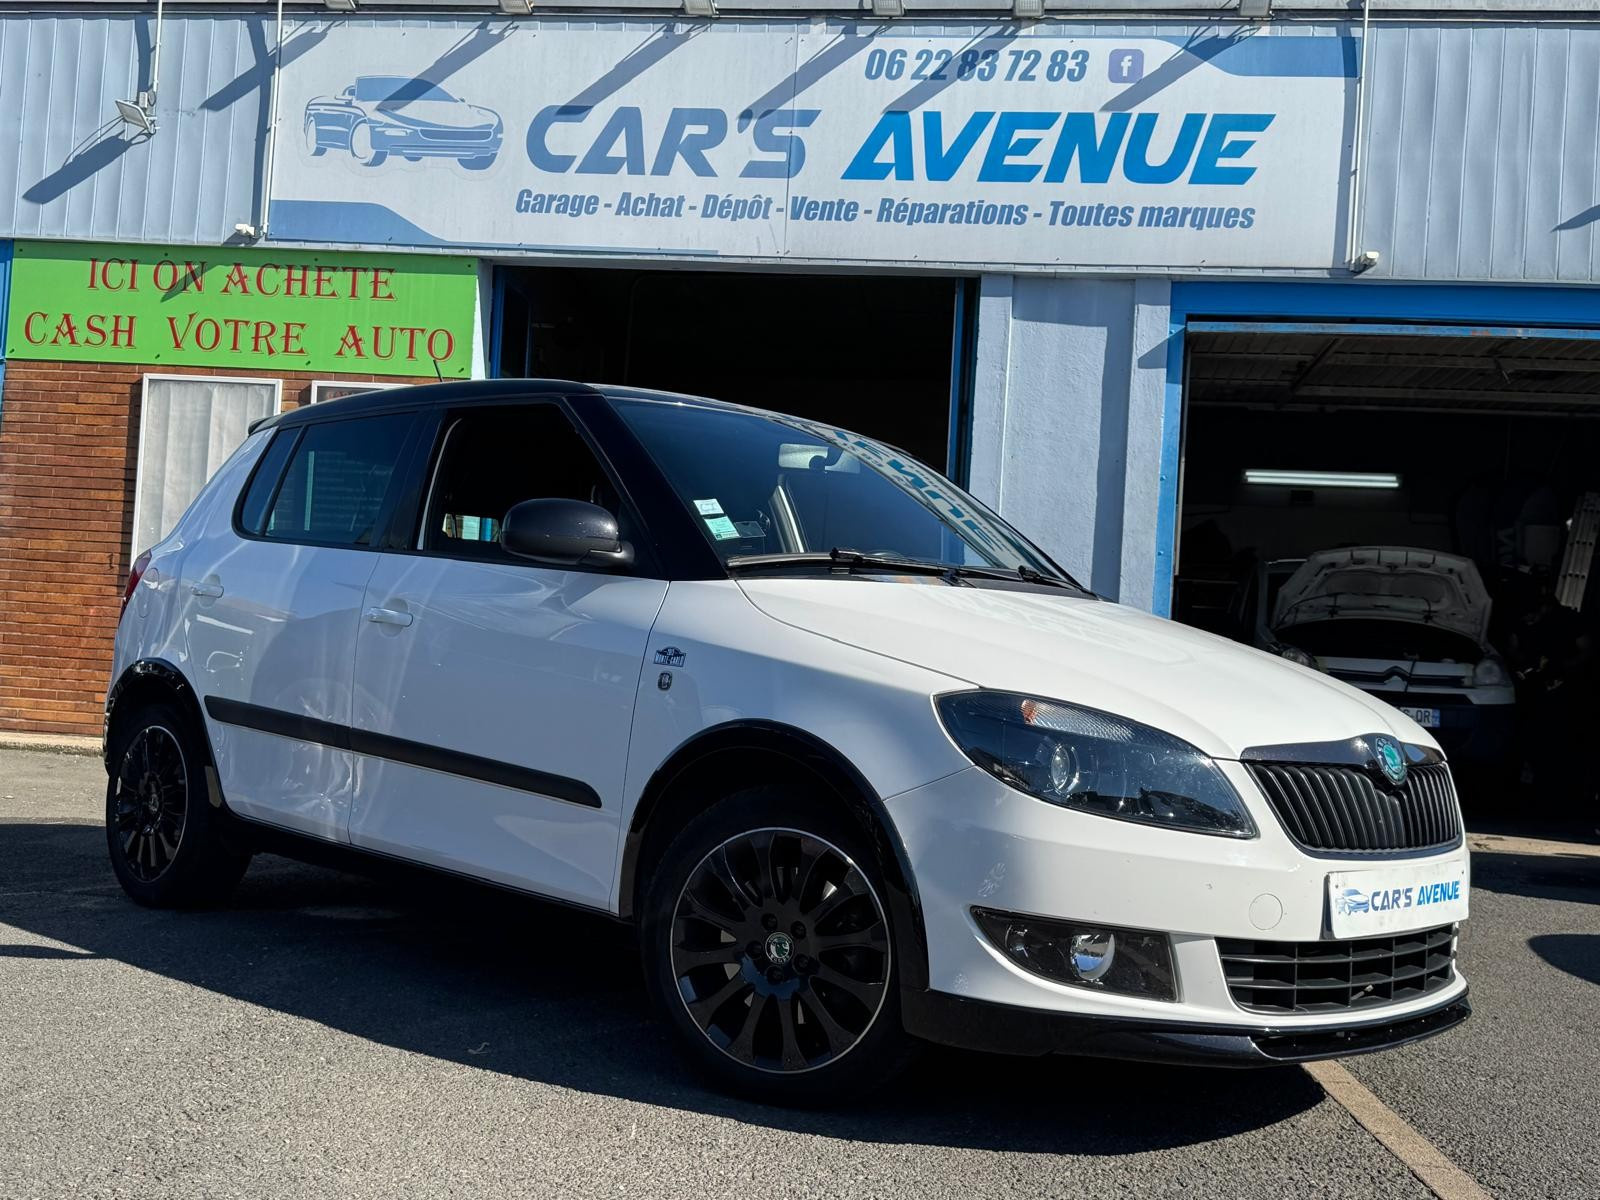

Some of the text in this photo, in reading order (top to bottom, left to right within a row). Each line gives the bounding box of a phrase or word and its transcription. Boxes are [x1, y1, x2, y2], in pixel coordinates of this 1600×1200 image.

[864, 48, 1090, 82] 06 22 83 72 83
[526, 105, 1277, 185] CAR'S AVENUE
[515, 188, 600, 218] Garage
[615, 192, 686, 217] Achat
[701, 193, 773, 222] Dépôt
[789, 195, 860, 222] Vente
[877, 197, 1029, 226] Réparations
[1048, 200, 1133, 227] Toutes
[1137, 205, 1257, 231] marques
[88, 257, 398, 301] ICI ON ACHETE
[24, 311, 456, 363] CASH VOTRE AUTO
[1371, 880, 1460, 911] CAR'S AVENUE
